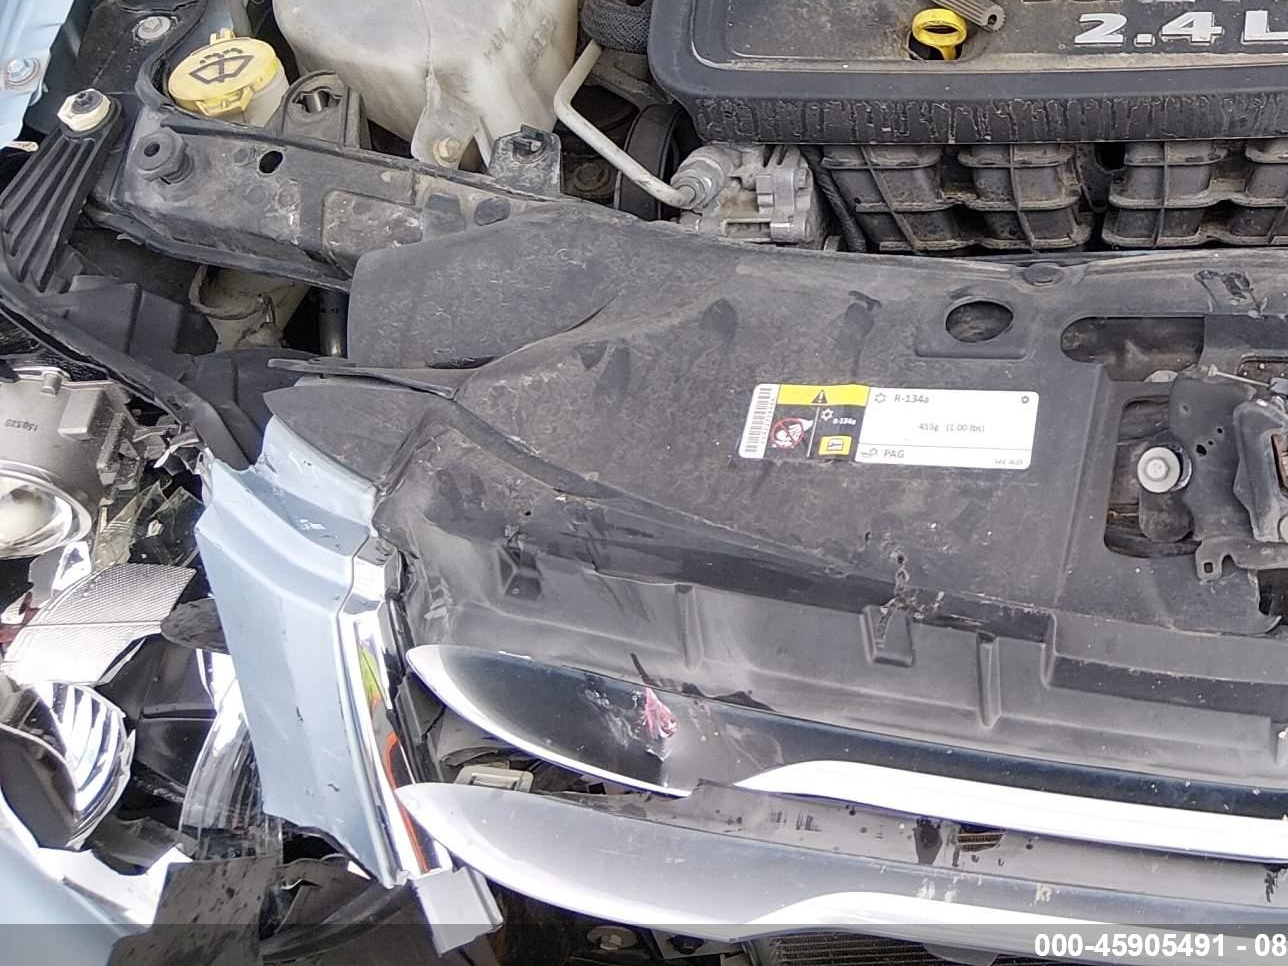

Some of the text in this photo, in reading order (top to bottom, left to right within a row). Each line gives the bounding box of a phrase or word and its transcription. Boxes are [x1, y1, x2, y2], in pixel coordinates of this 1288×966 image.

[1073, 11, 1225, 47] 2.4
[894, 394, 930, 404] R-134a
[918, 423, 939, 432] 455g
[883, 449, 905, 459] PAG
